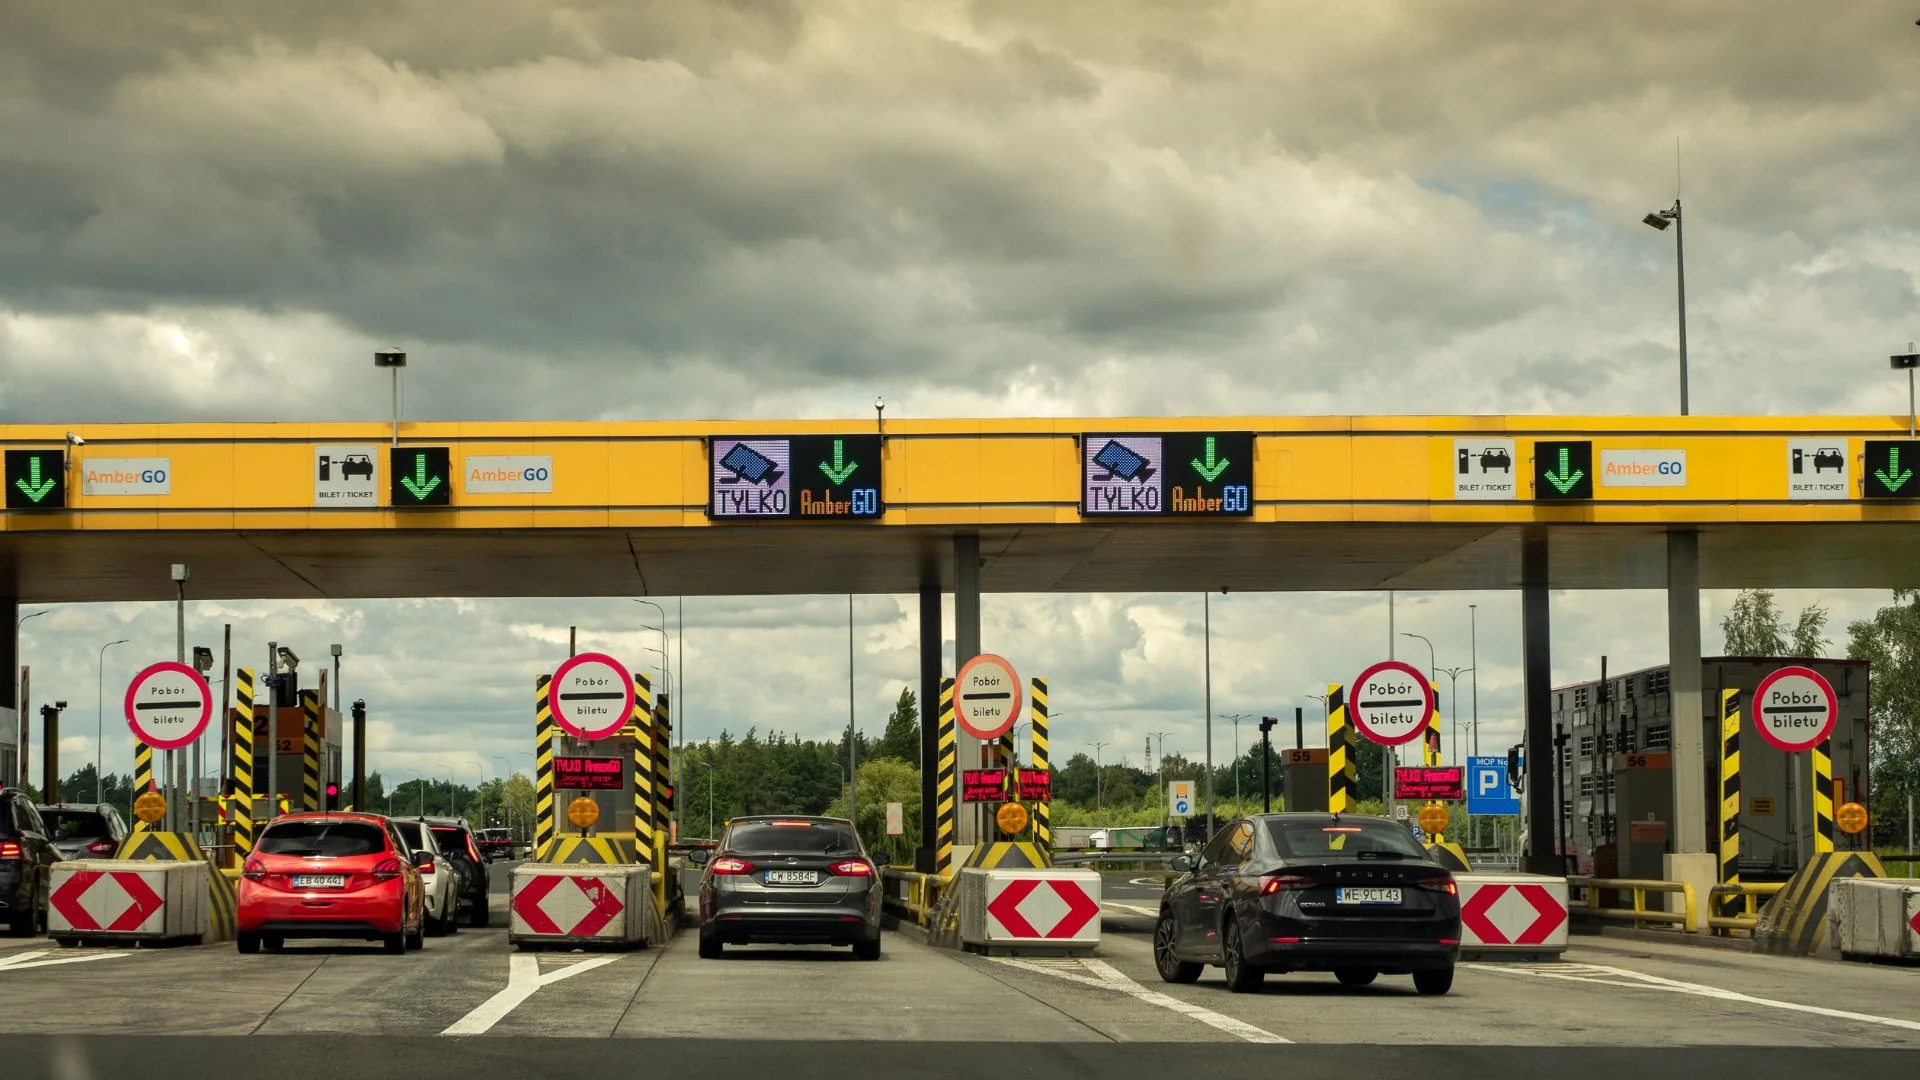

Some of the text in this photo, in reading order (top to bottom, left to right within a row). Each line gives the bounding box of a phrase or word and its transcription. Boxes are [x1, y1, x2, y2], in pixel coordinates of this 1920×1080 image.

[1606, 460, 1682, 475] AmberGO
[87, 470, 166, 483] AmberGO
[470, 468, 548, 481] AmberGO
[718, 489, 787, 514] TYLKO
[801, 488, 877, 515] AmberGO
[1090, 486, 1159, 511] TYLKO
[1172, 485, 1248, 512] AmberGO
[575, 677, 608, 686] Pobór
[973, 675, 1000, 686] Pobór
[151, 686, 185, 695] Pobór
[1369, 682, 1412, 695] Pobór
[1772, 691, 1818, 704] Pobór
[577, 706, 607, 715] biletu
[973, 706, 1001, 717] biletu
[153, 715, 184, 724] biletu
[1370, 712, 1413, 725] biletu
[1773, 715, 1818, 728] biletu
[1292, 751, 1311, 762] 55
[1476, 758, 1495, 766] MOP
[1628, 756, 1646, 767] 56
[1480, 770, 1499, 796] P
[300, 875, 312, 885] EB
[770, 871, 816, 881] CW 8584F
[1344, 889, 1399, 901] WE 9CT43
